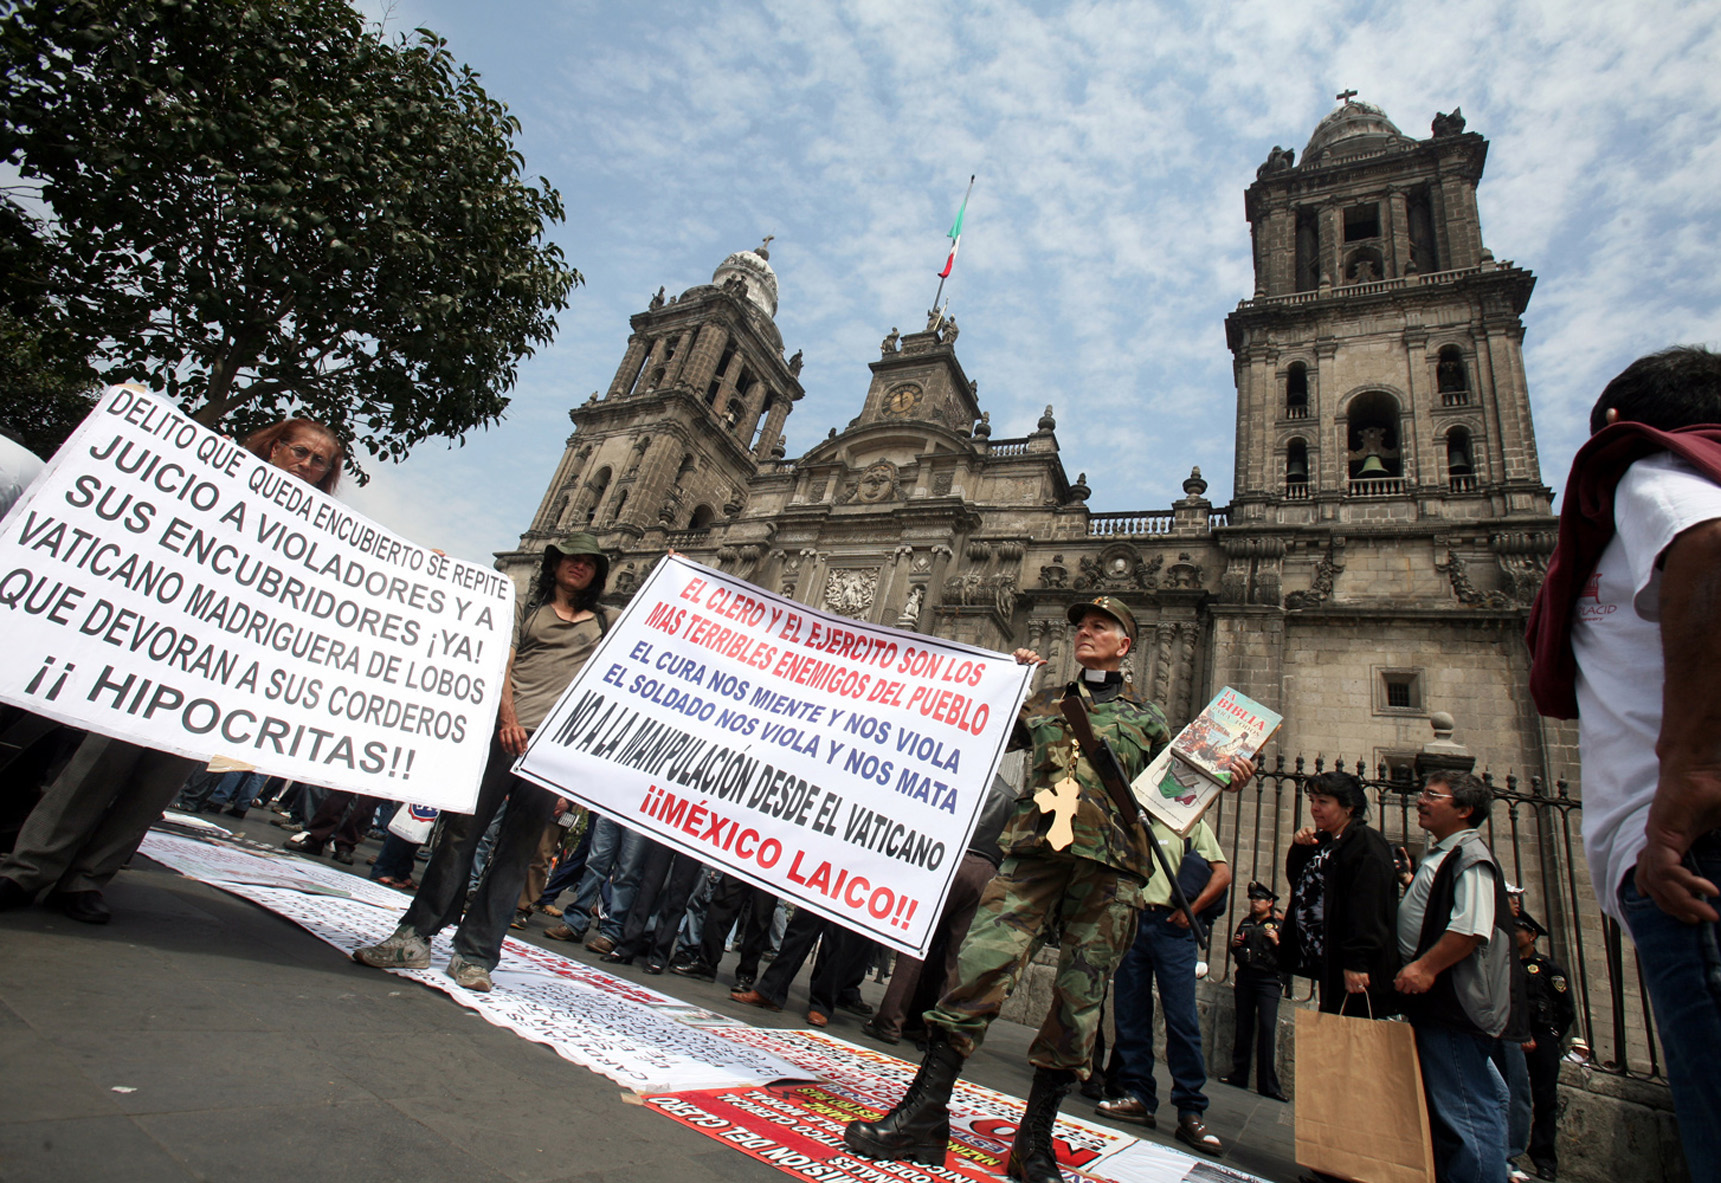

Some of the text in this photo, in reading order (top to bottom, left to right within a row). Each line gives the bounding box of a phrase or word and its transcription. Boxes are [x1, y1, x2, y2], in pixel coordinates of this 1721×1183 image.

[89, 435, 493, 630] JUICIO A VIOLADORES Y A
[106, 390, 508, 600] DELITO QUE QUEDA ENCUBIERTO SE REPITE
[18, 511, 485, 704] VATICANO MADRIGUERA DE LOBOS
[65, 475, 483, 663] SUS ENCUBRIDORES ¡YA!
[680, 578, 986, 686] EL CLERO Y EL EJERCITO SON LOS
[1578, 604, 1617, 616] LACID
[1, 568, 466, 743] QUE DEVORAN A SUS CORDEROS
[87, 665, 415, 779] HIPOCRITAS!!
[629, 641, 960, 774] EL CURA NOS MIENTE Y NOS VIOLA
[645, 602, 989, 736] MAS TERRIBLES ENEMIGOS DEL PUEBLO
[1217, 697, 1265, 731] BIBLIA
[1224, 690, 1237, 701] LA
[551, 690, 945, 871] NO A LA MANIPULACIÓN DESDE EL VATICANO
[603, 664, 957, 814] EL SOLDADO NOS VIOLA Y NOS MATA
[640, 785, 918, 930] ¡¡MÉXICO LAICO!!
[647, 1097, 731, 1128] CLERO
[717, 1093, 798, 1125] CLERICAL
[719, 1126, 777, 1149] DEL
[744, 1090, 811, 1117] MORAL
